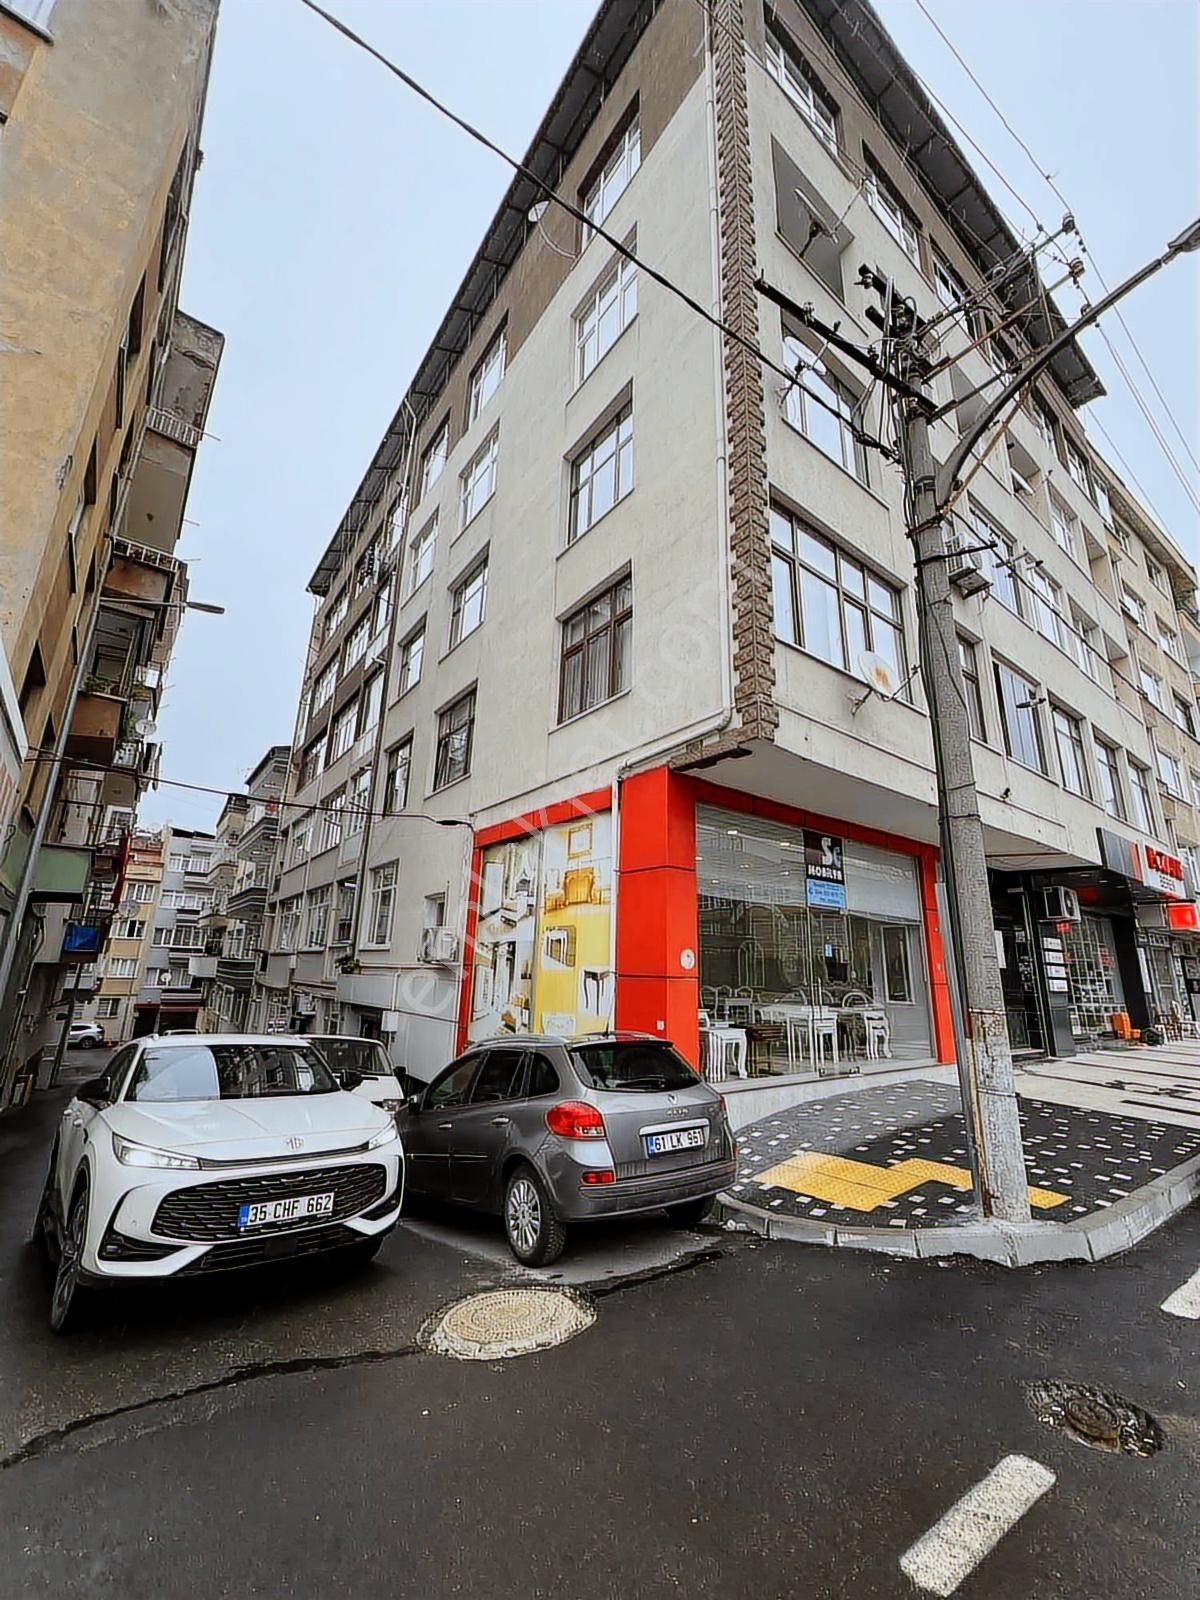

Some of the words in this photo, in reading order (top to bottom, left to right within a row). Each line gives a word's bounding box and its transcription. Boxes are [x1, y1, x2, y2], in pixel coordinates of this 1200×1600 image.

[655, 1136, 666, 1151] 61
[670, 1134, 683, 1148] LK
[687, 1131, 701, 1145] 961
[250, 1206, 267, 1222] 35
[274, 1200, 299, 1219] CHF
[307, 1195, 332, 1212] 662
